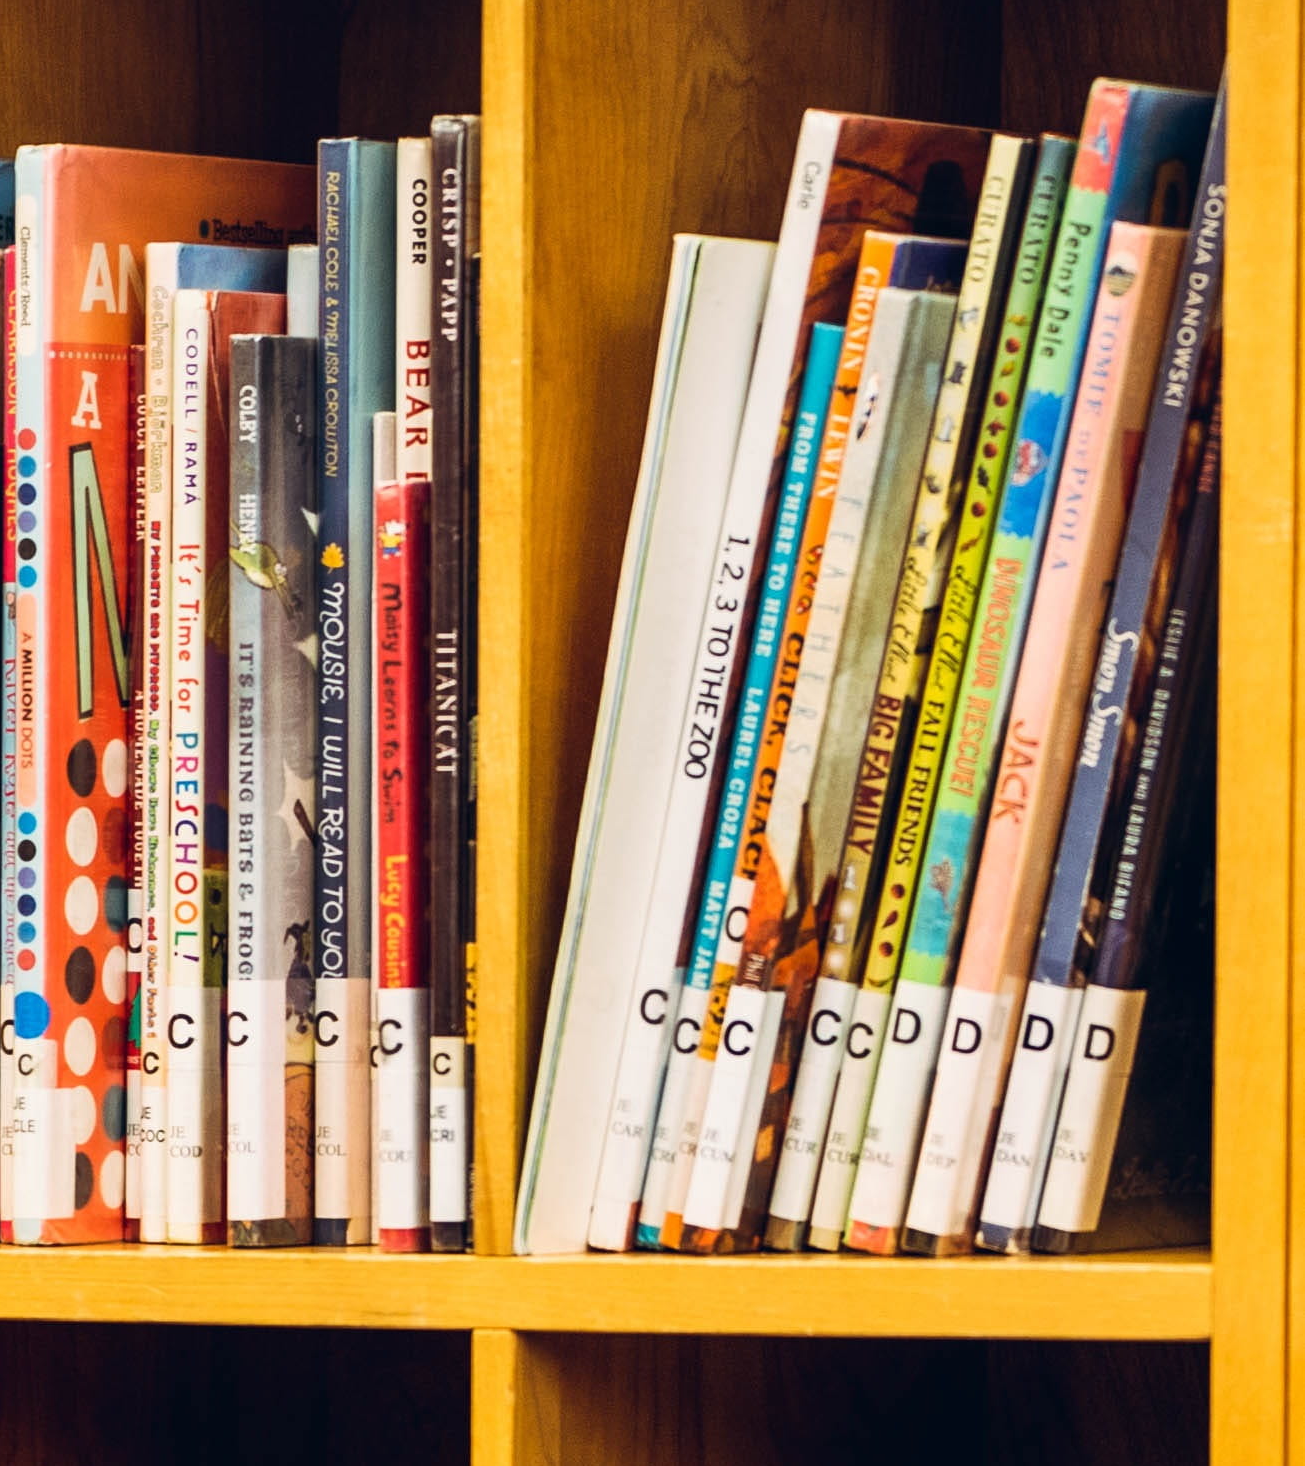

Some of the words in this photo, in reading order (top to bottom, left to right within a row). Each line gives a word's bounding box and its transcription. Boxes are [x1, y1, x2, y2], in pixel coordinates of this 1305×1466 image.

[410, 178, 427, 267] COOPER
[183, 328, 200, 418] CODELL
[404, 339, 431, 449] BEAR
[716, 595, 738, 612] 3
[707, 625, 733, 657] TO
[695, 665, 726, 719] THE
[868, 694, 902, 742] BIG
[684, 723, 715, 779] ZOO
[993, 721, 1040, 824] JACK
[844, 749, 892, 860] FAMILY
[173, 731, 200, 964] PRESCHOOL!
[1022, 1014, 1054, 1050] D
